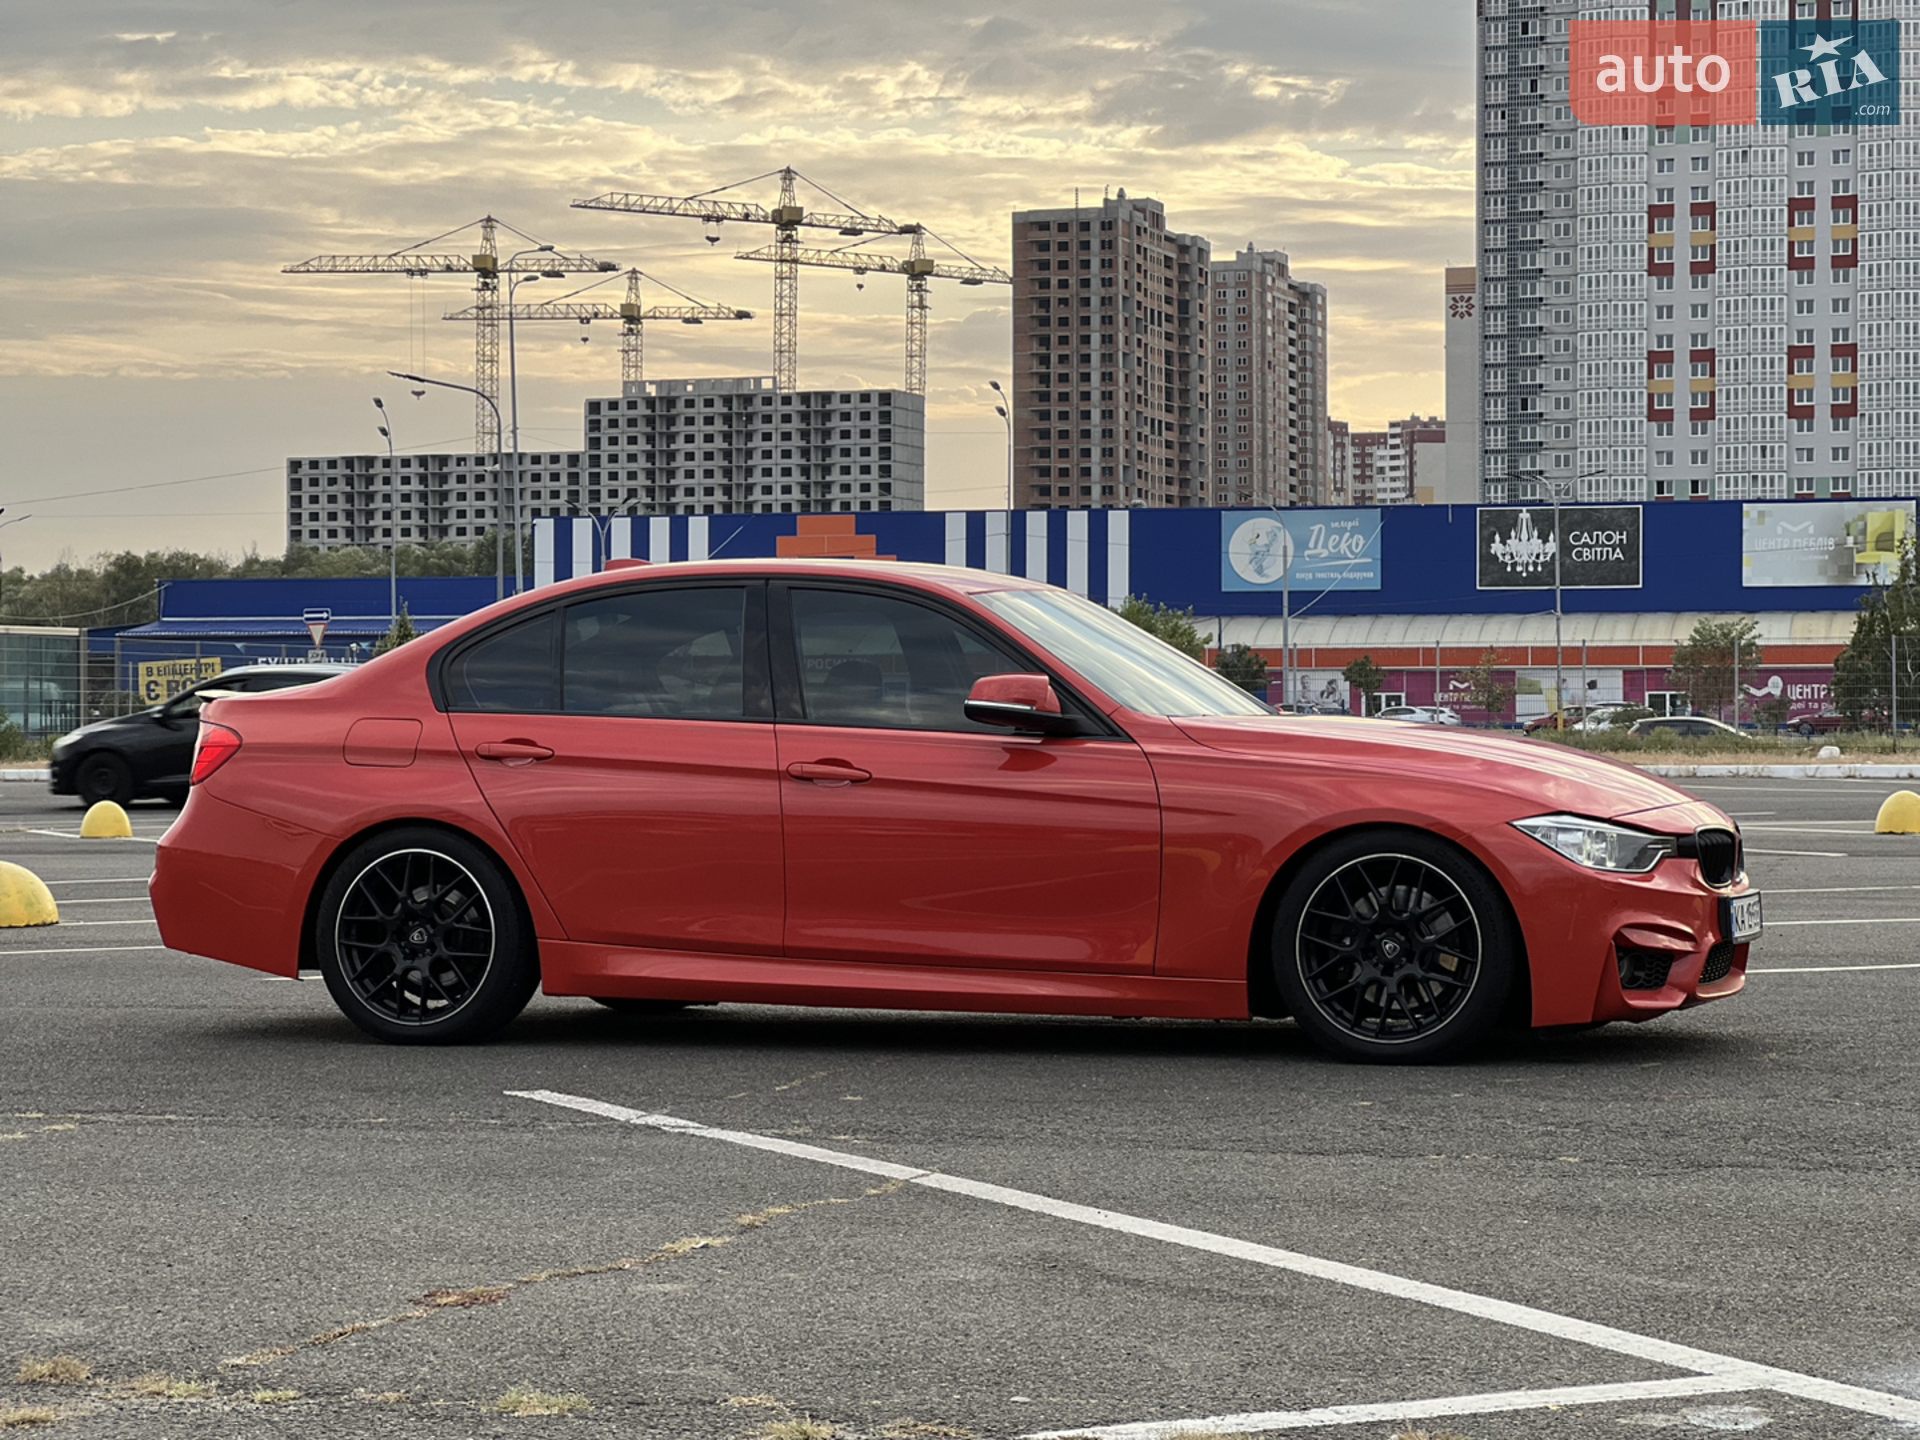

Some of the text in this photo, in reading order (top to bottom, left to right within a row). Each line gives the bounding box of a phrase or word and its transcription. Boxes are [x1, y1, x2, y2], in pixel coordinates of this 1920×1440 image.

[1304, 524, 1365, 561] Деко
[1569, 530, 1627, 545] САЛОН
[1755, 537, 1835, 551] ЦЕНТР МЕБЛІВ
[1572, 547, 1625, 562] СВІТЛА
[146, 666, 153, 677] В
[146, 680, 160, 701] Є
[1787, 684, 1829, 700] ЦЕНТР
